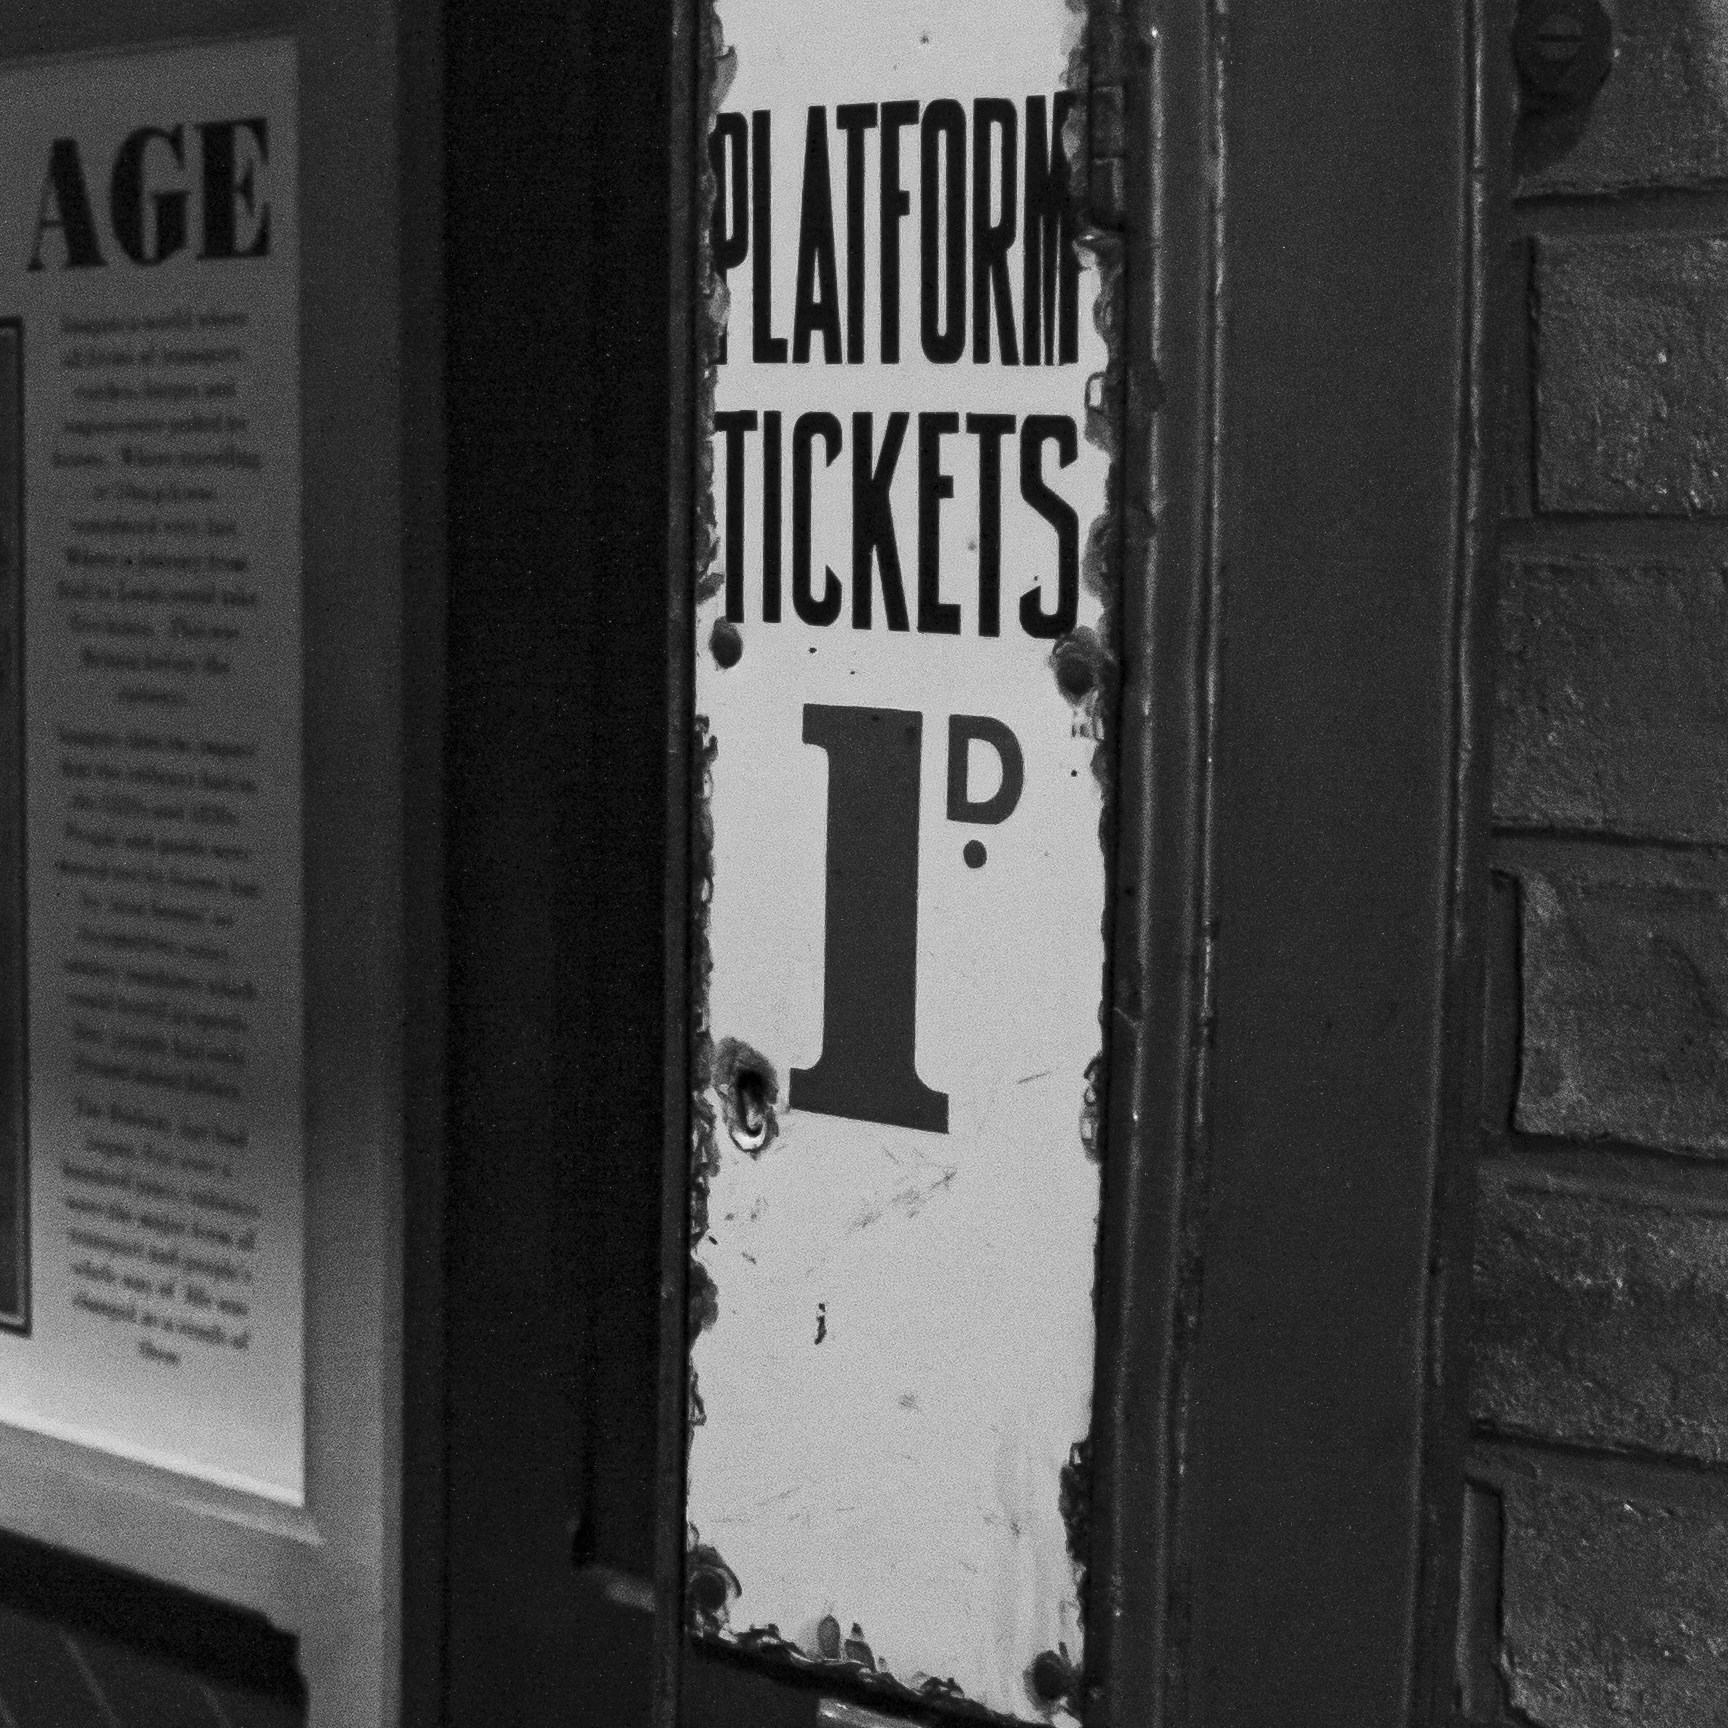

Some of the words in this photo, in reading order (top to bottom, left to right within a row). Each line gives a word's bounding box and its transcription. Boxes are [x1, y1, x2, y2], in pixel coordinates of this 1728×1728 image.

[27, 116, 270, 274] AGE
[709, 90, 1080, 367] PLATFORM
[713, 409, 1080, 640] TICKETS
